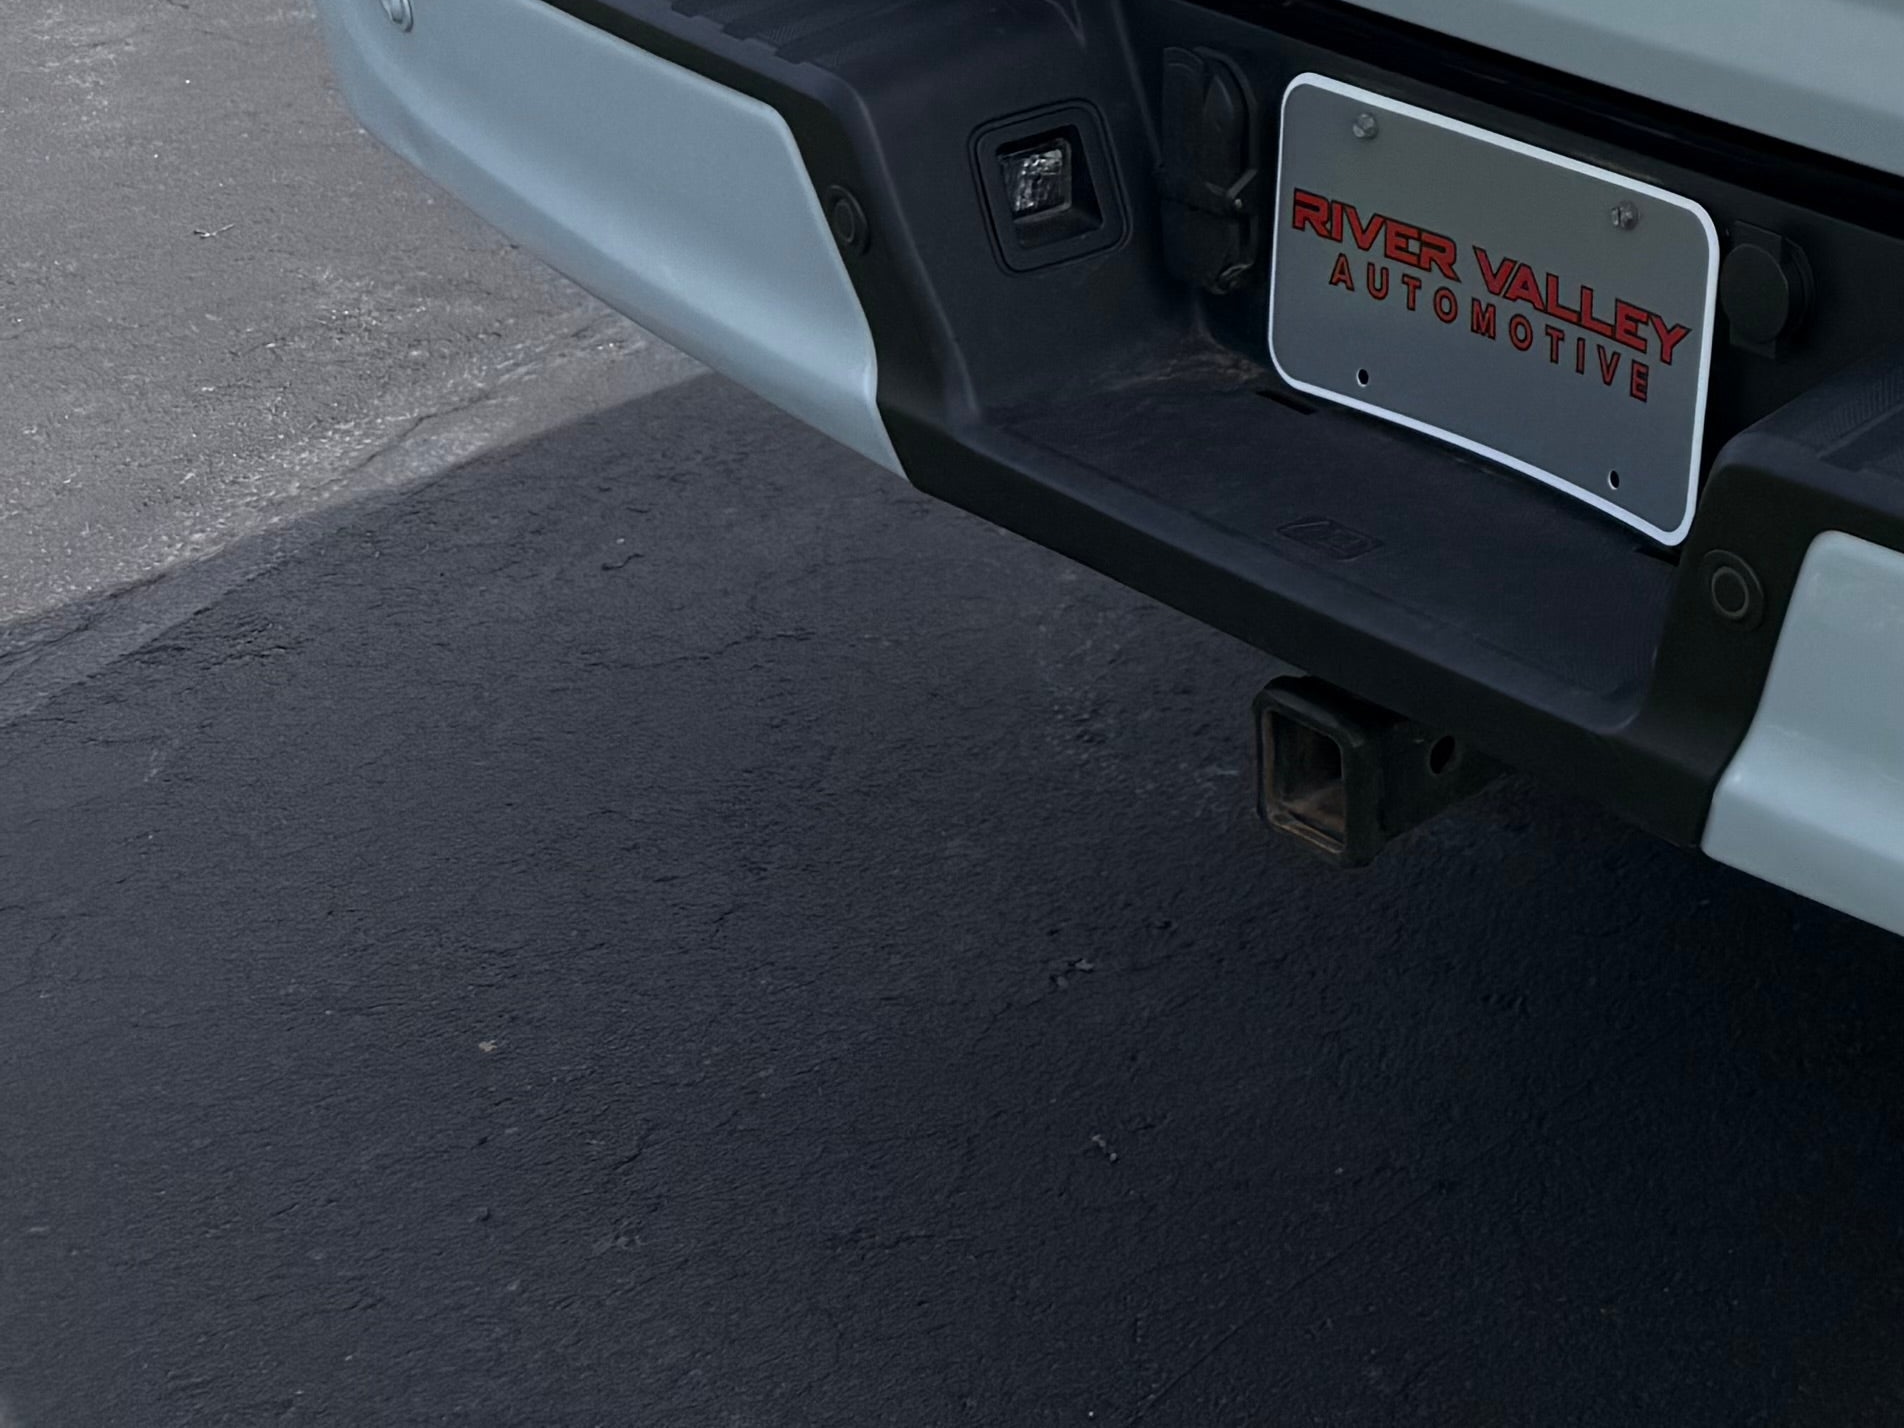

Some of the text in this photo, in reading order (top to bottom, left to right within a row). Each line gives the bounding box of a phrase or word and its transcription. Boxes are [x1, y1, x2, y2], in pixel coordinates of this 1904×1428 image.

[1292, 188, 1692, 365] RIVER VALLEY
[1328, 252, 1649, 403] AUTOMOTIVE
